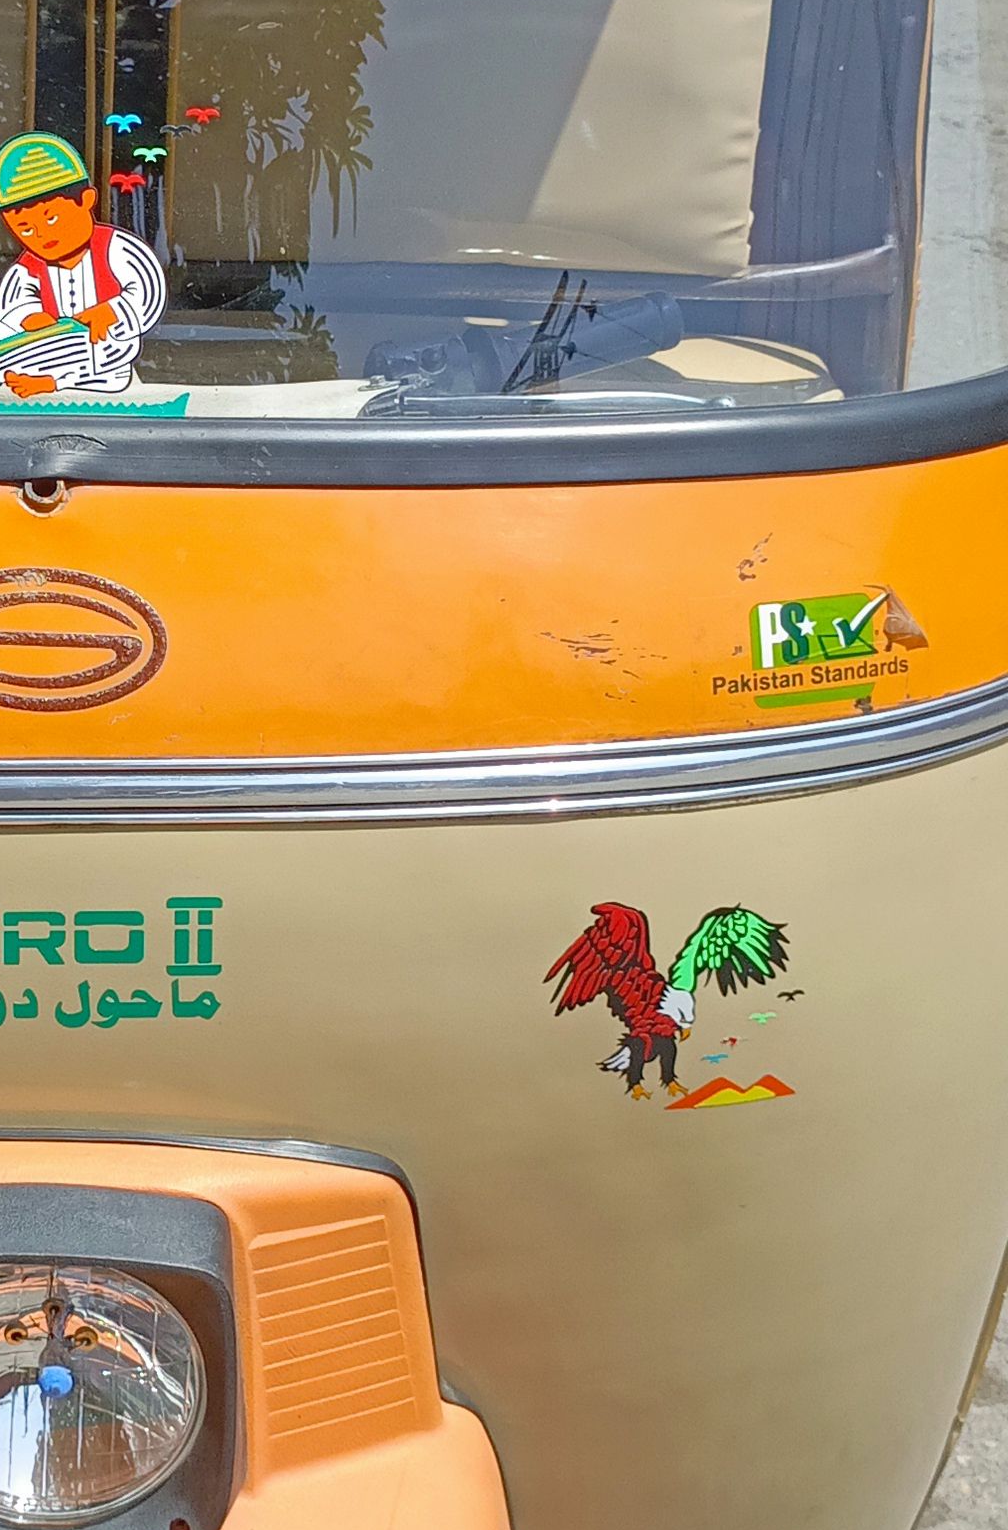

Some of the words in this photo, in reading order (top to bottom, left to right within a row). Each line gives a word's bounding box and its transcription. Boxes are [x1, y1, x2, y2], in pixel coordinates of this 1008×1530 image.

[712, 672, 804, 696] Pakistan
[810, 656, 909, 685] Standards
[166, 896, 224, 977] II
[54, 978, 222, 1030] ماحول
